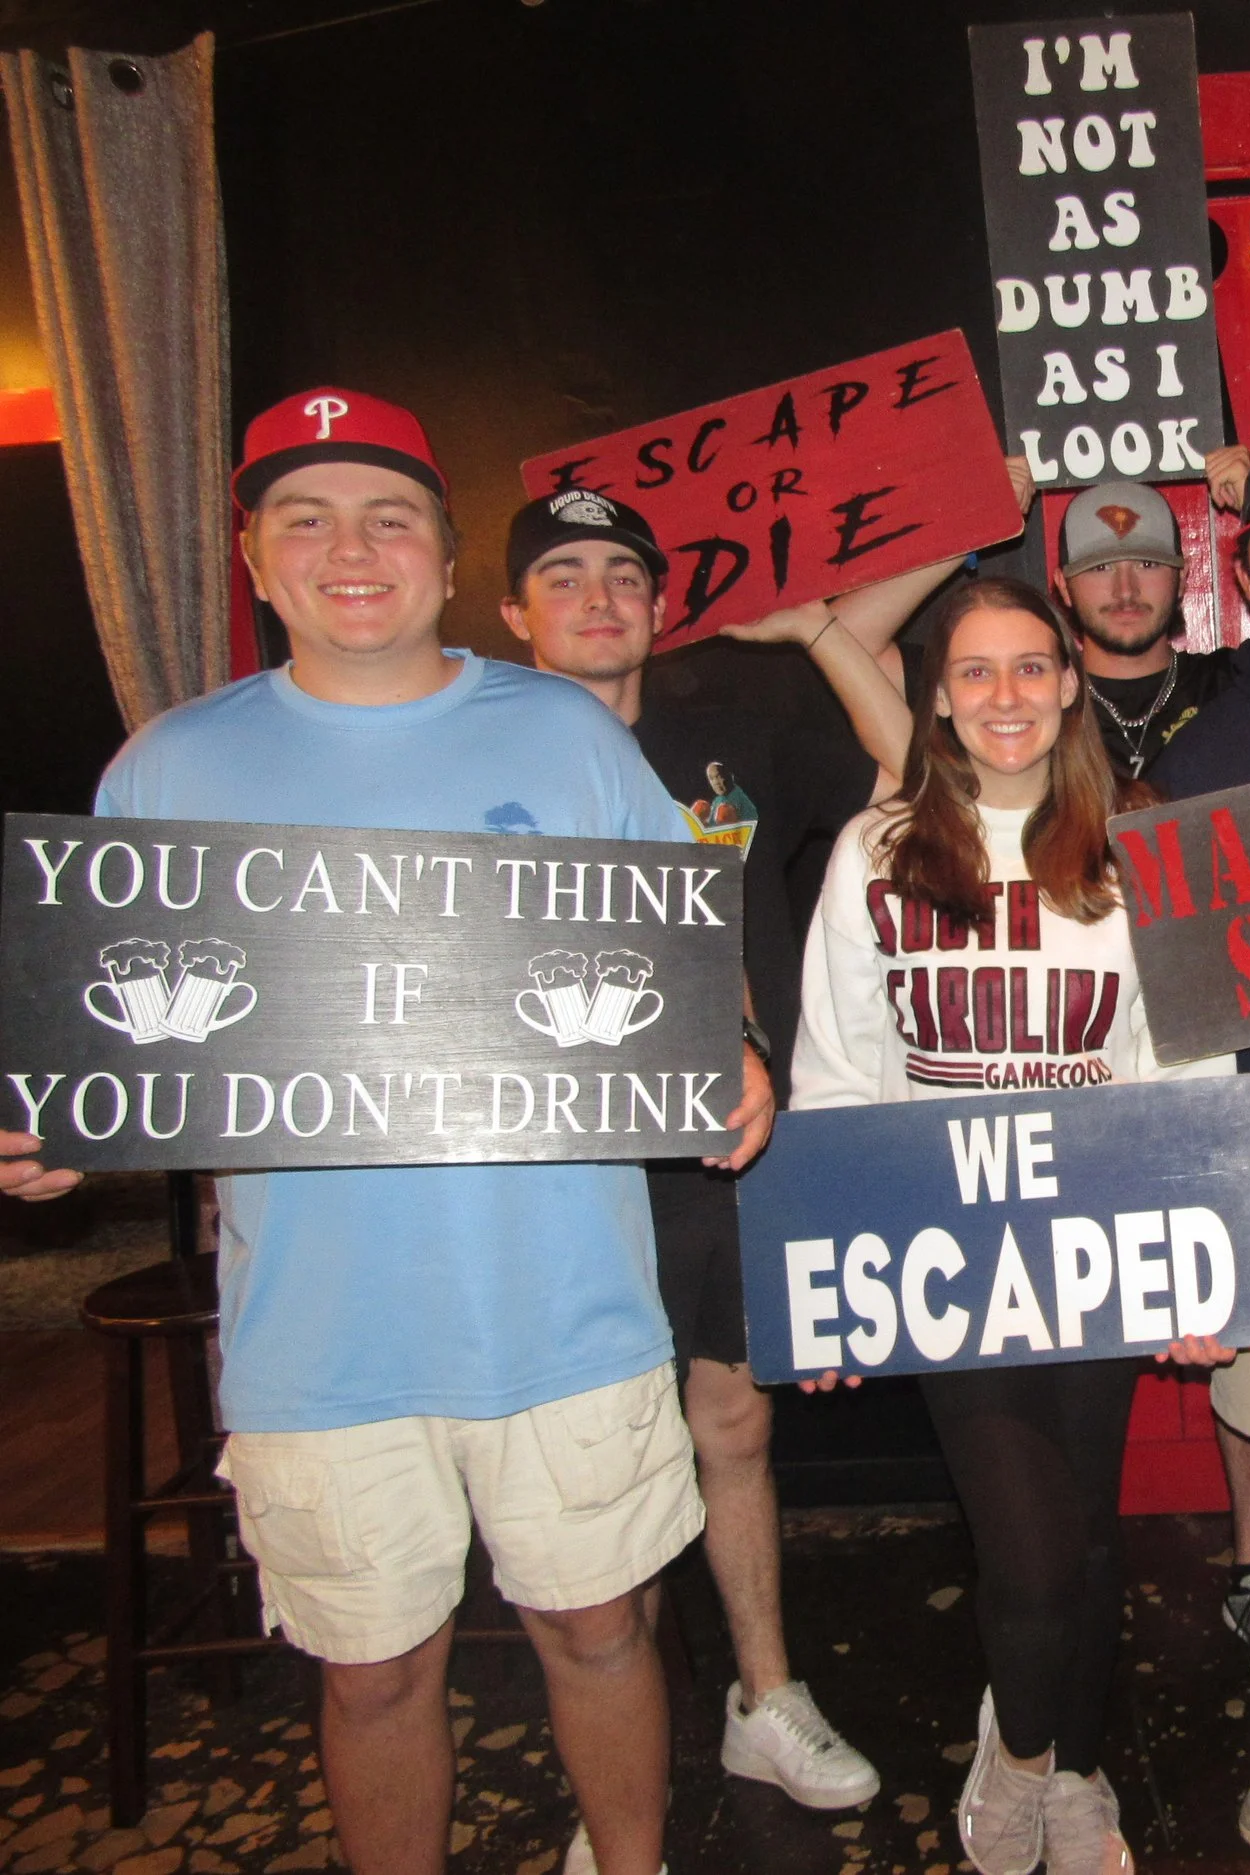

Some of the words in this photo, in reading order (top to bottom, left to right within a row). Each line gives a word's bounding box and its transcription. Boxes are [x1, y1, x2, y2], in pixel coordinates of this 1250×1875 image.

[1023, 33, 1140, 95] I'M
[1017, 111, 1156, 175] NOT
[1048, 192, 1141, 251] AS
[996, 266, 1208, 333] DUMB
[1037, 348, 1131, 406] AS
[1156, 344, 1184, 397] I
[304, 396, 349, 439] P
[549, 355, 960, 493] ESCAPE
[1019, 418, 1206, 482] LOOK
[550, 490, 581, 515] LIQUID
[726, 467, 808, 513] OR
[670, 485, 936, 634] DIE
[24, 839, 211, 910] YOU
[236, 846, 473, 917] CAN'T
[495, 859, 727, 927] THINK
[359, 962, 430, 1025] IF
[6, 1072, 196, 1141] YOU
[220, 1072, 464, 1139] DON'T
[491, 1072, 728, 1135] DRINK
[947, 1112, 1059, 1205] WE
[785, 1206, 1236, 1371] ESCAPED
